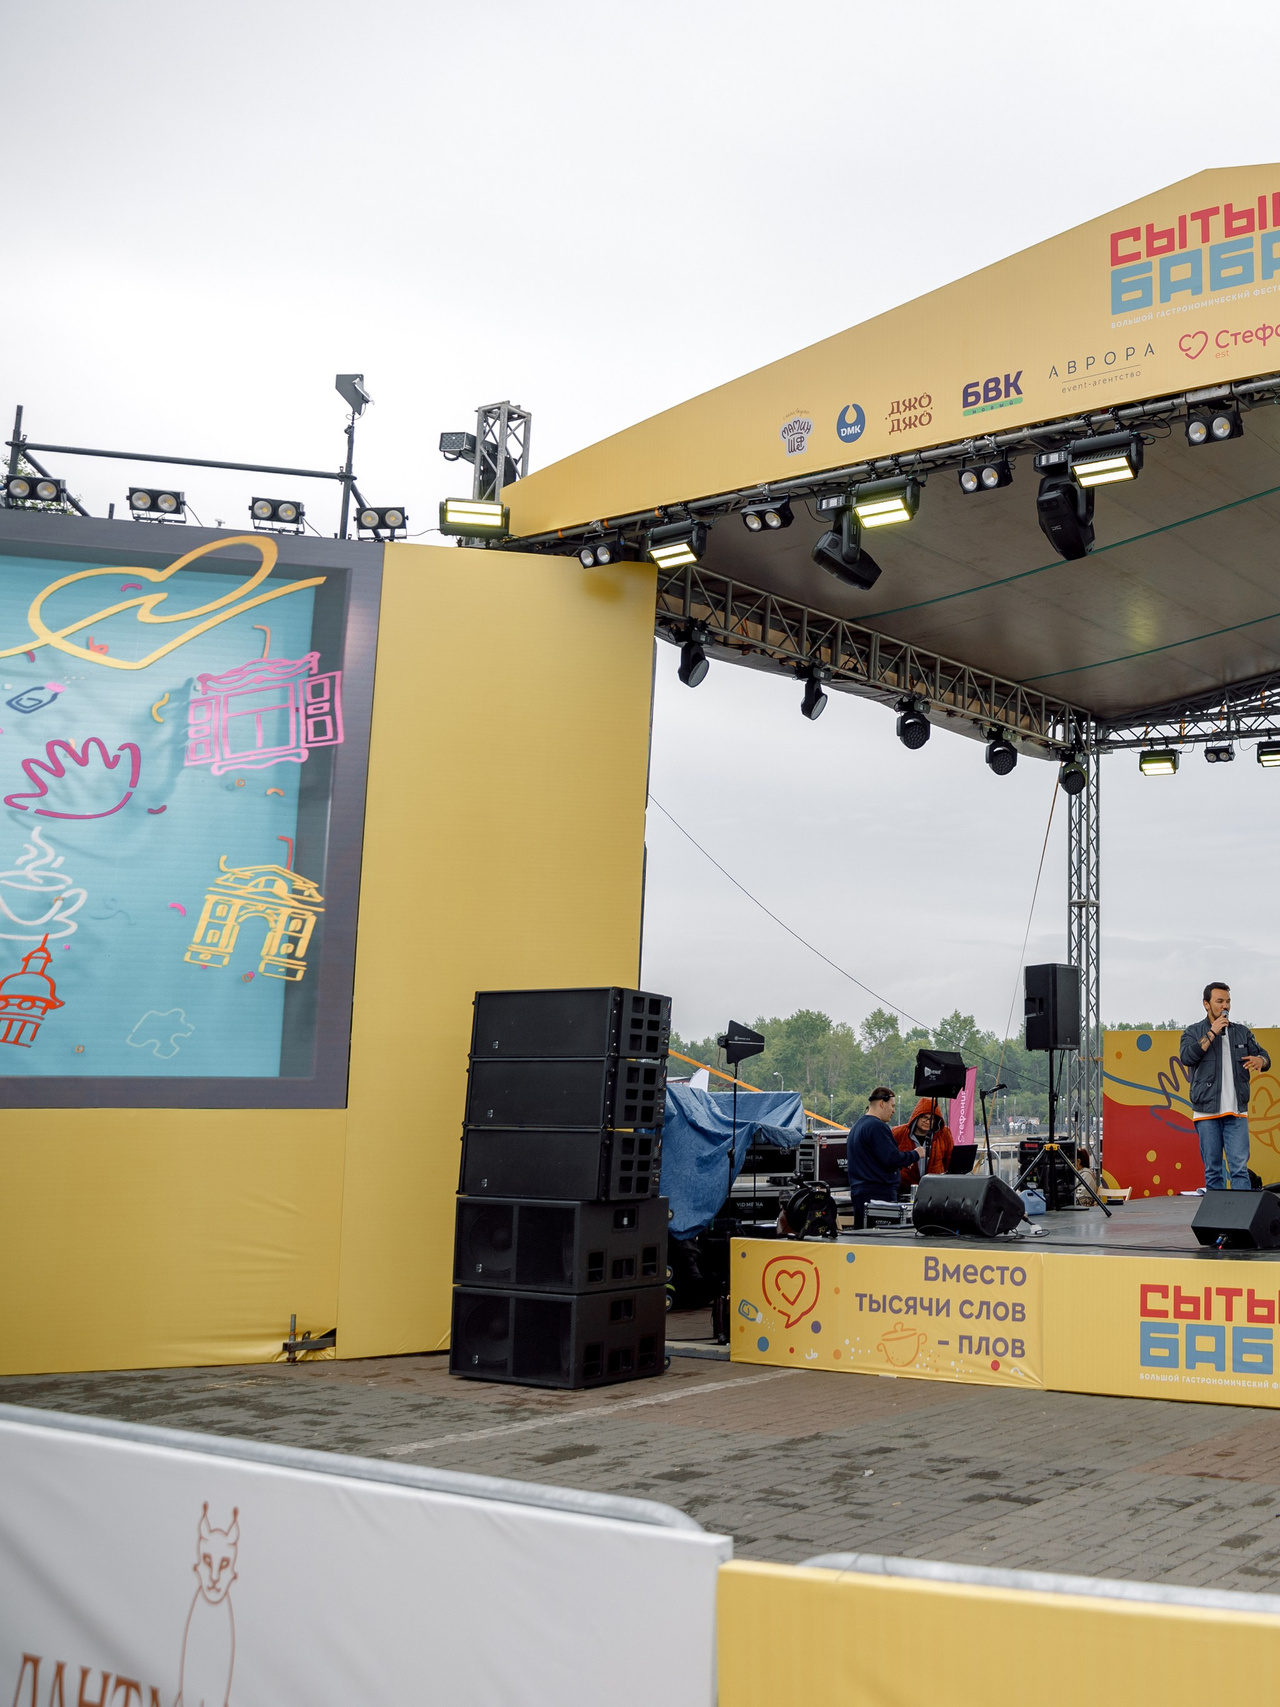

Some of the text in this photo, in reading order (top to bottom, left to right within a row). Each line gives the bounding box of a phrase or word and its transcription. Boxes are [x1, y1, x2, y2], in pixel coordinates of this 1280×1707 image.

[1111, 311, 1154, 329] БОЛЬШОЙ
[1156, 289, 1250, 319] ГАСТРОНОМИЧЕСКИЙ
[1048, 343, 1155, 379] АВРОРА
[1215, 349, 1230, 359] est
[962, 370, 1023, 409] БВК
[1062, 370, 1141, 394] event-агентство
[924, 1256, 1027, 1287] Вместо
[855, 1293, 1027, 1322] тысячи слов
[958, 1335, 1026, 1358] плов
[1140, 1372, 1180, 1383] БОЛЬШОЙ
[1182, 1376, 1269, 1388] ГАСТРОНОМИЧЕСКИЙ
